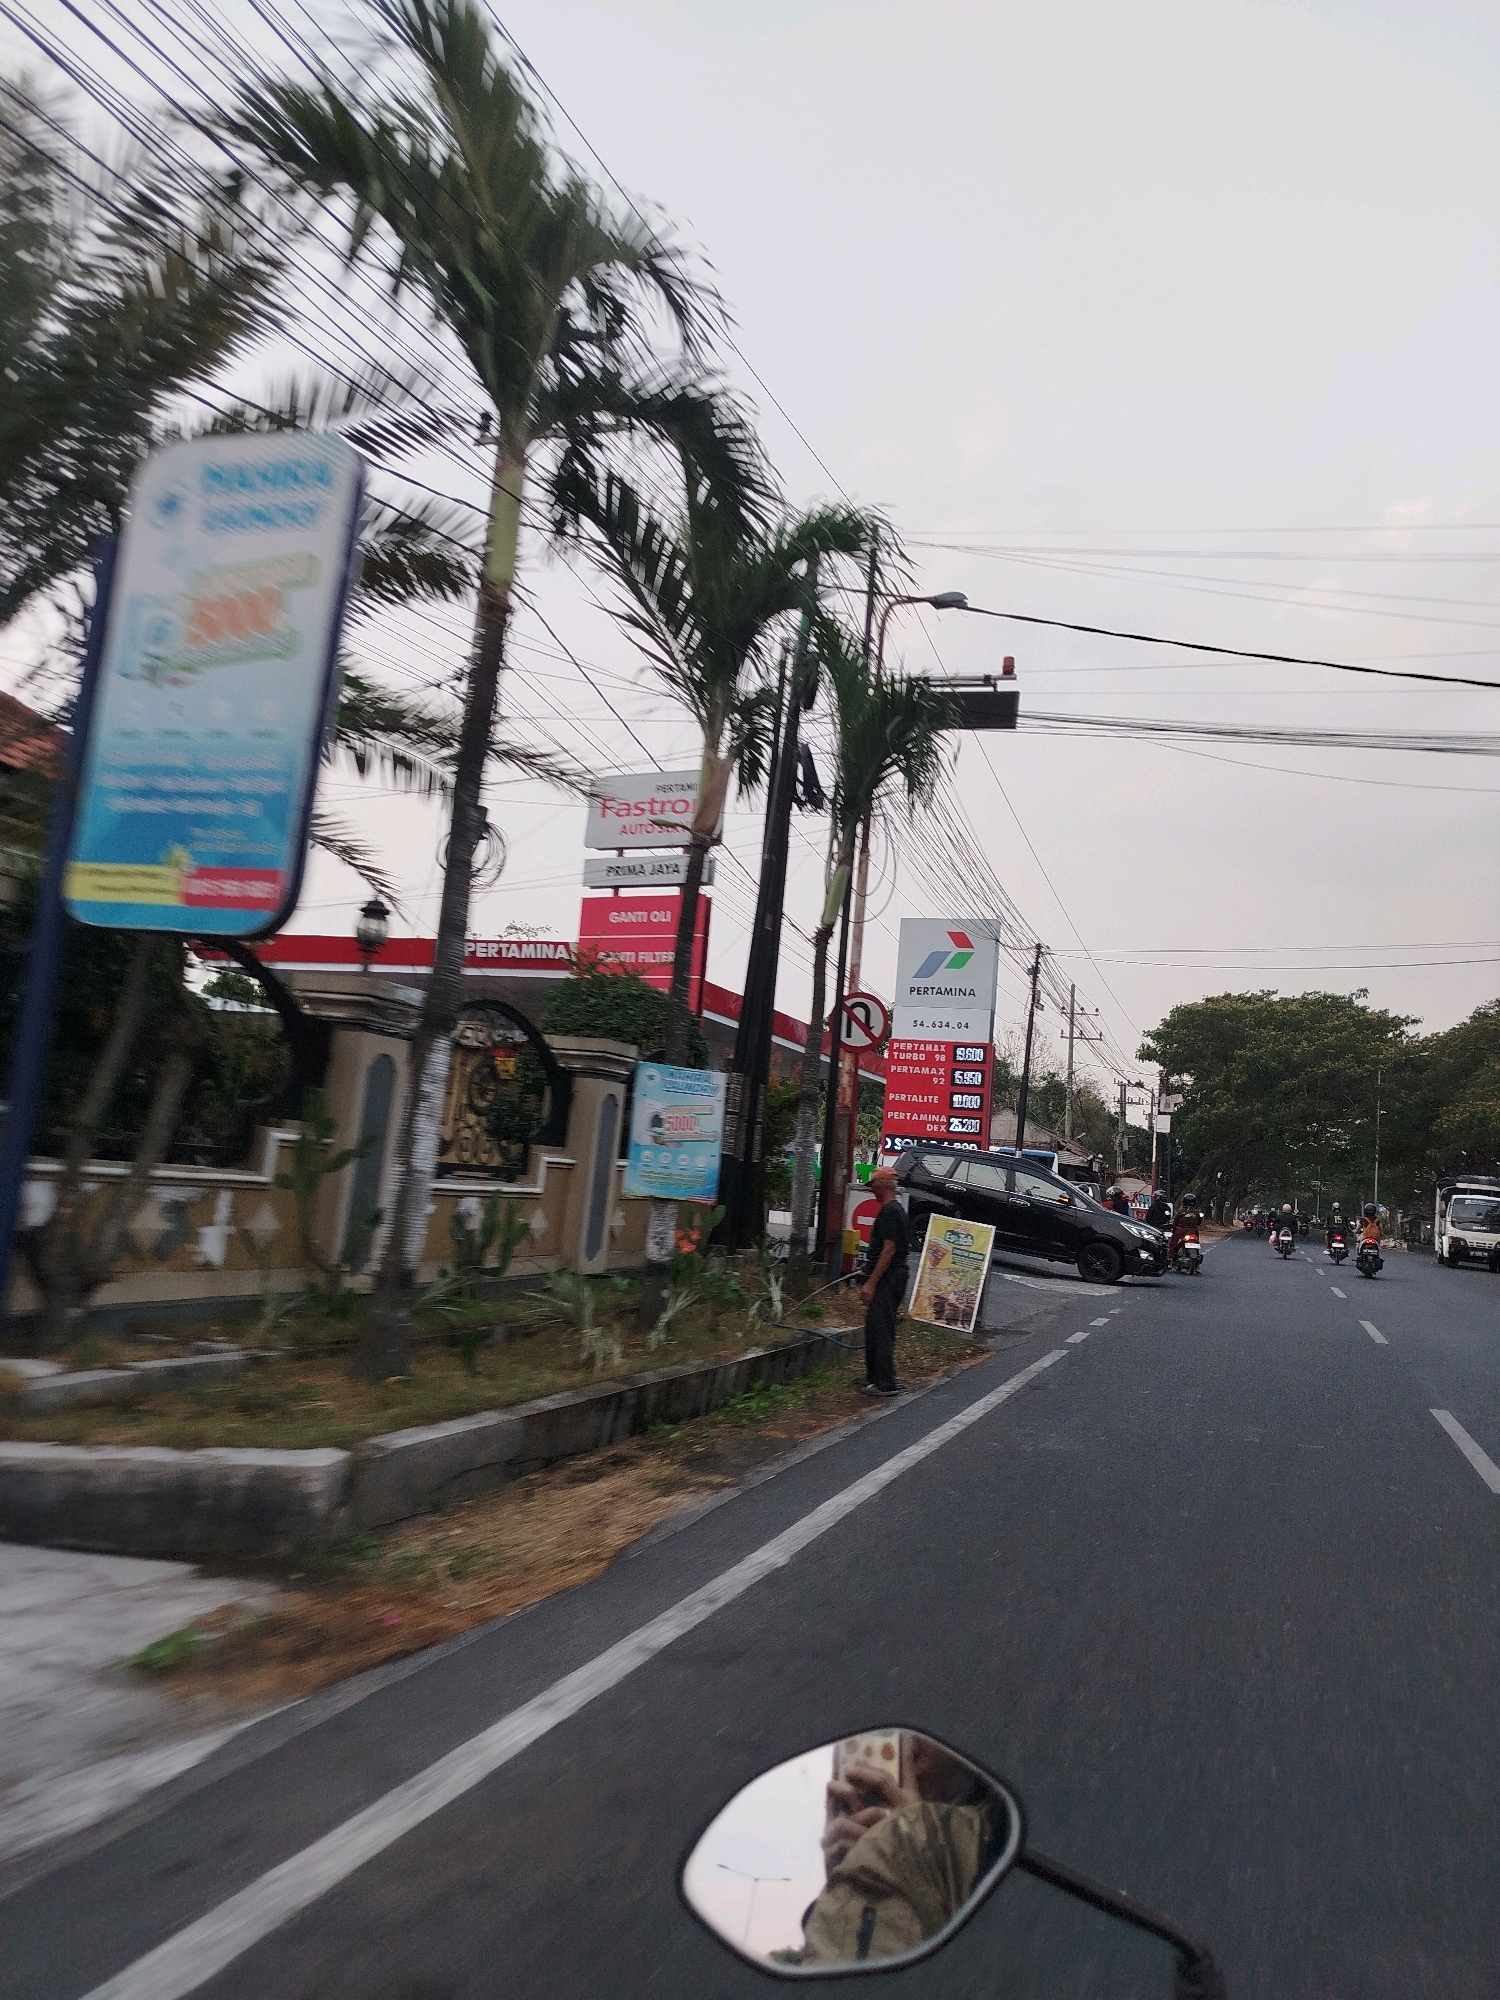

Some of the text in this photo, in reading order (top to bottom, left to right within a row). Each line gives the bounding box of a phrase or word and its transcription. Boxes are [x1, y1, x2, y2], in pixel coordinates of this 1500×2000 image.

[619, 823, 655, 836] AUTO
[606, 863, 681, 877] PRIMA JAYA
[608, 911, 672, 922] GANTI OLI
[464, 943, 570, 960] PERTAMINA
[638, 952, 676, 962] FILTER
[909, 986, 976, 997] PERTAMINA
[893, 1042, 946, 1052] PERTAMAX
[893, 1052, 946, 1062] TURBO 98
[890, 1065, 945, 1076] PERTAMAX
[932, 1077, 945, 1085] 92
[888, 1093, 939, 1103] PERTALITE
[887, 1111, 947, 1123] PERTAMINA
[926, 1123, 947, 1132] DEX
